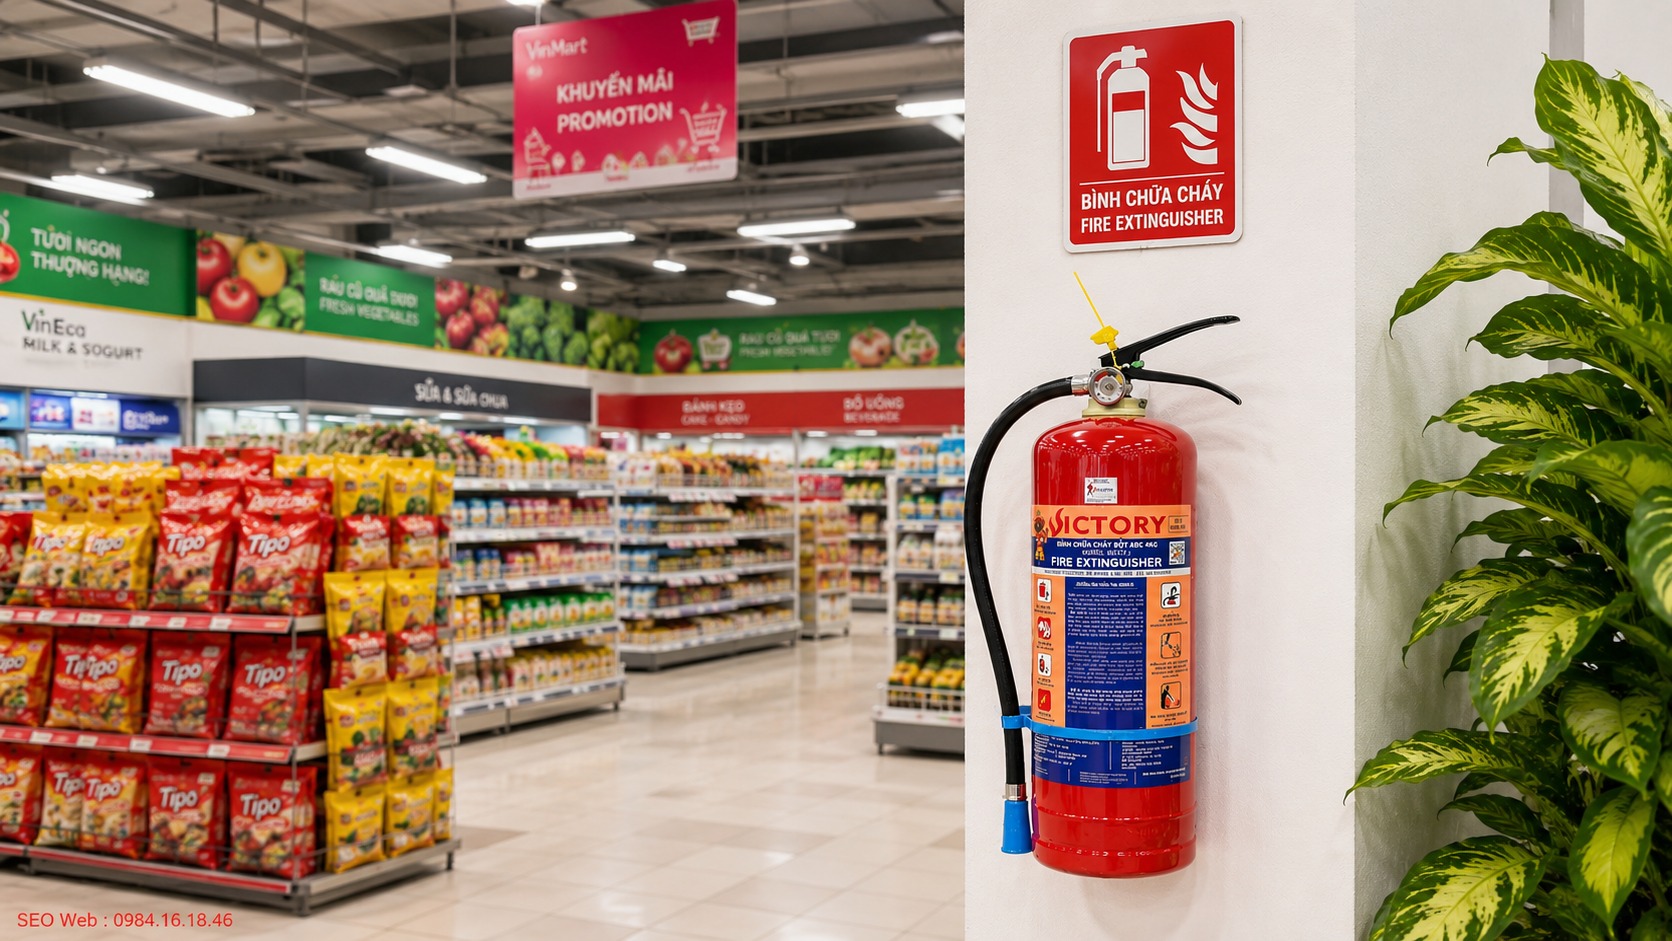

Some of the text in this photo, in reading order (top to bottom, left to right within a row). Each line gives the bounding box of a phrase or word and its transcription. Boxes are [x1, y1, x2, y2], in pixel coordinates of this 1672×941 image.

[526, 37, 587, 60] VinMart
[556, 101, 674, 134] PROMOTION
[1080, 178, 1224, 210] BÌNH CHỮA CHÁY
[1080, 208, 1224, 233] FIRE EXTINGUISHER
[23, 337, 61, 354] MILK
[1048, 507, 1167, 537] VICTORY
[167, 532, 205, 557] Tipo
[247, 533, 290, 558] Tipo
[1051, 556, 1163, 568] FIRE EXTINGUISHER
[162, 660, 203, 685] Tipo
[244, 663, 286, 688] Tipo
[87, 778, 121, 801] Tipo
[159, 786, 198, 812] Tipo
[240, 793, 281, 820] Tipo
